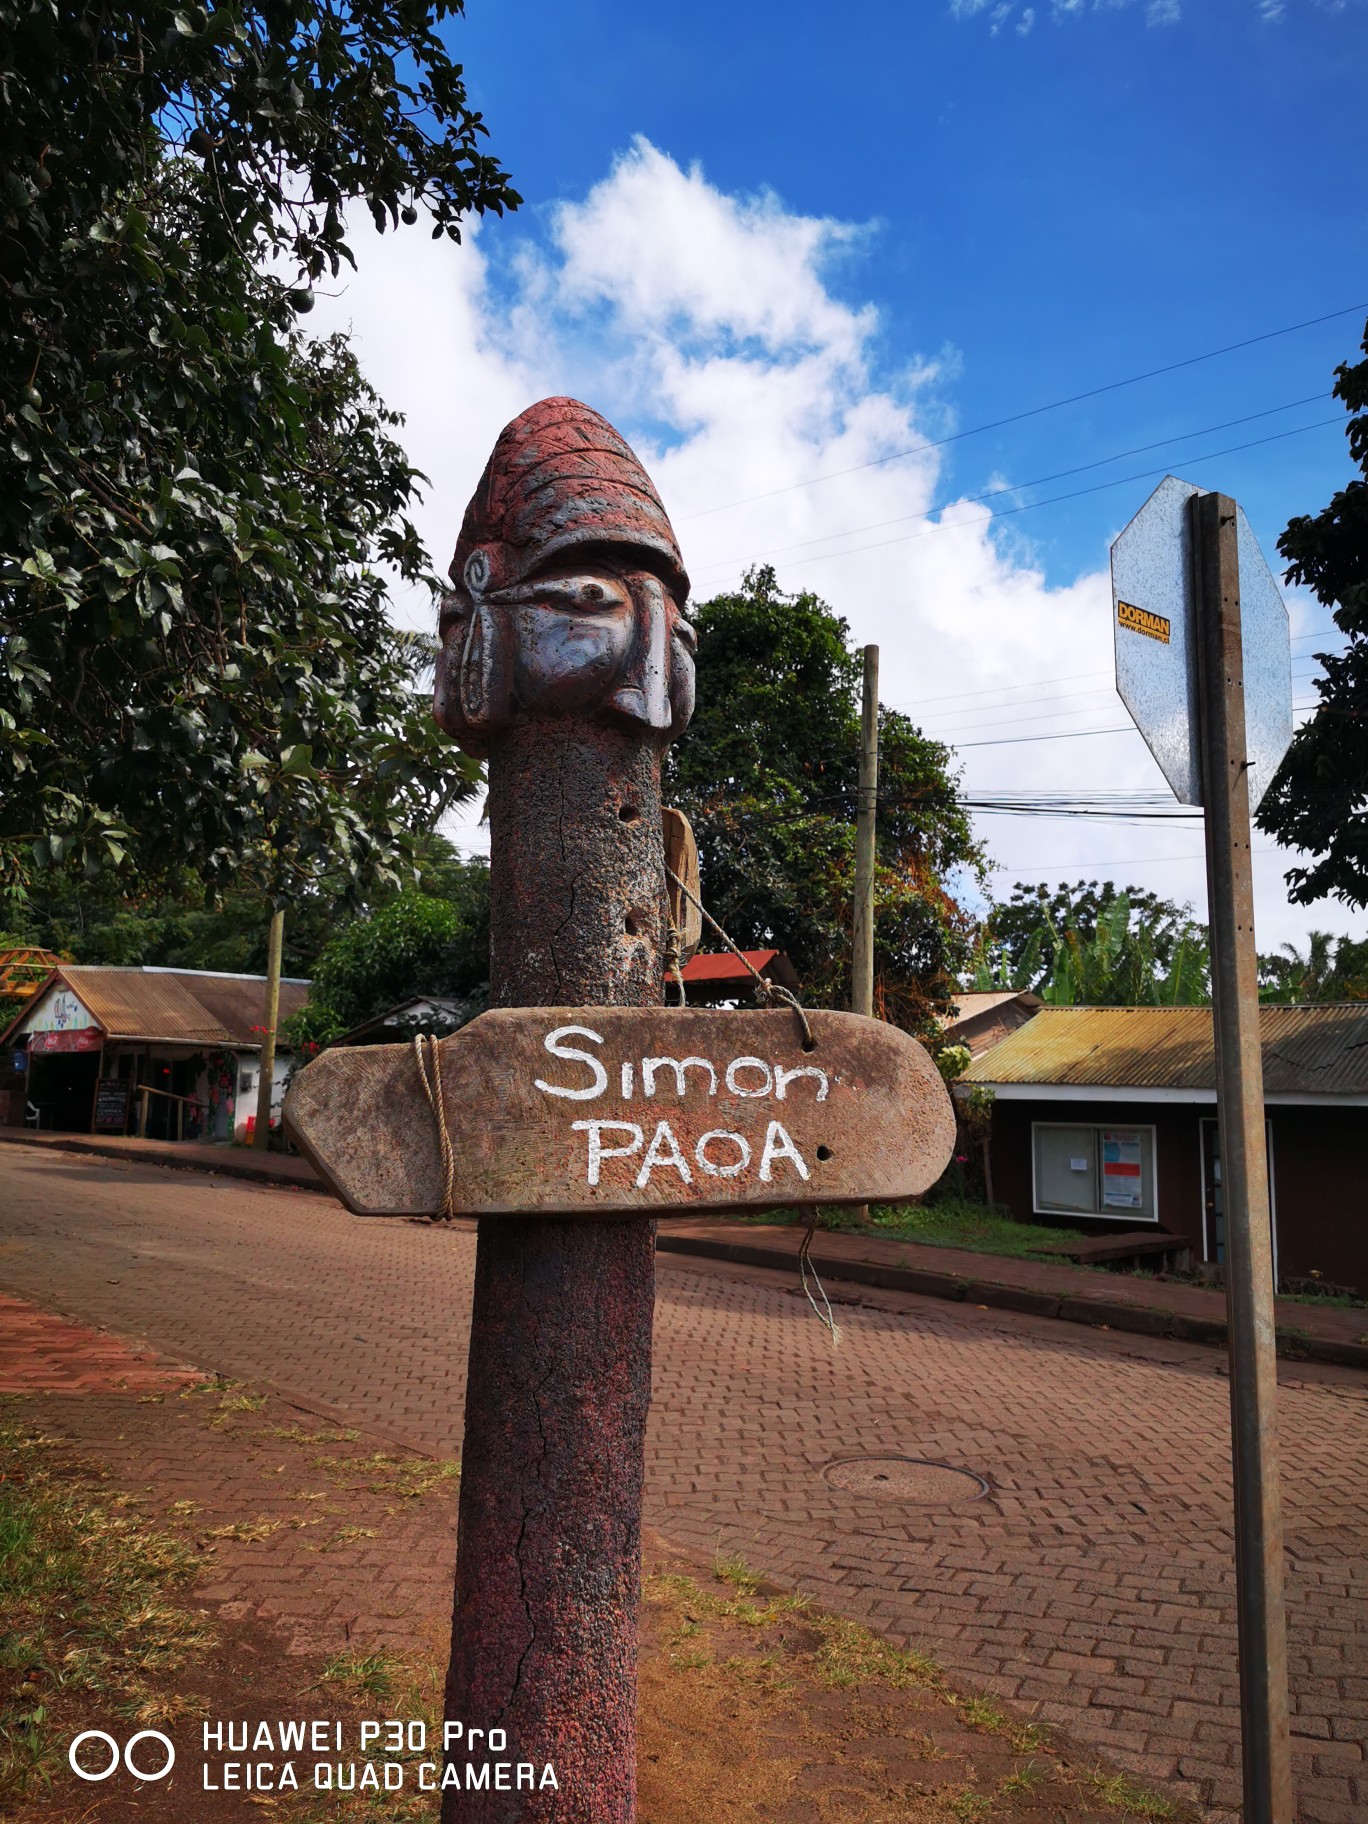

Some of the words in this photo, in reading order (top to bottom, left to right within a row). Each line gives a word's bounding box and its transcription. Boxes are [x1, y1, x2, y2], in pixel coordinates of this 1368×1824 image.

[1118, 620, 1170, 645] www.dorman.cl
[1119, 603, 1170, 635] DORMAN
[534, 1025, 829, 1102] Simon
[571, 1119, 811, 1188] PAOA
